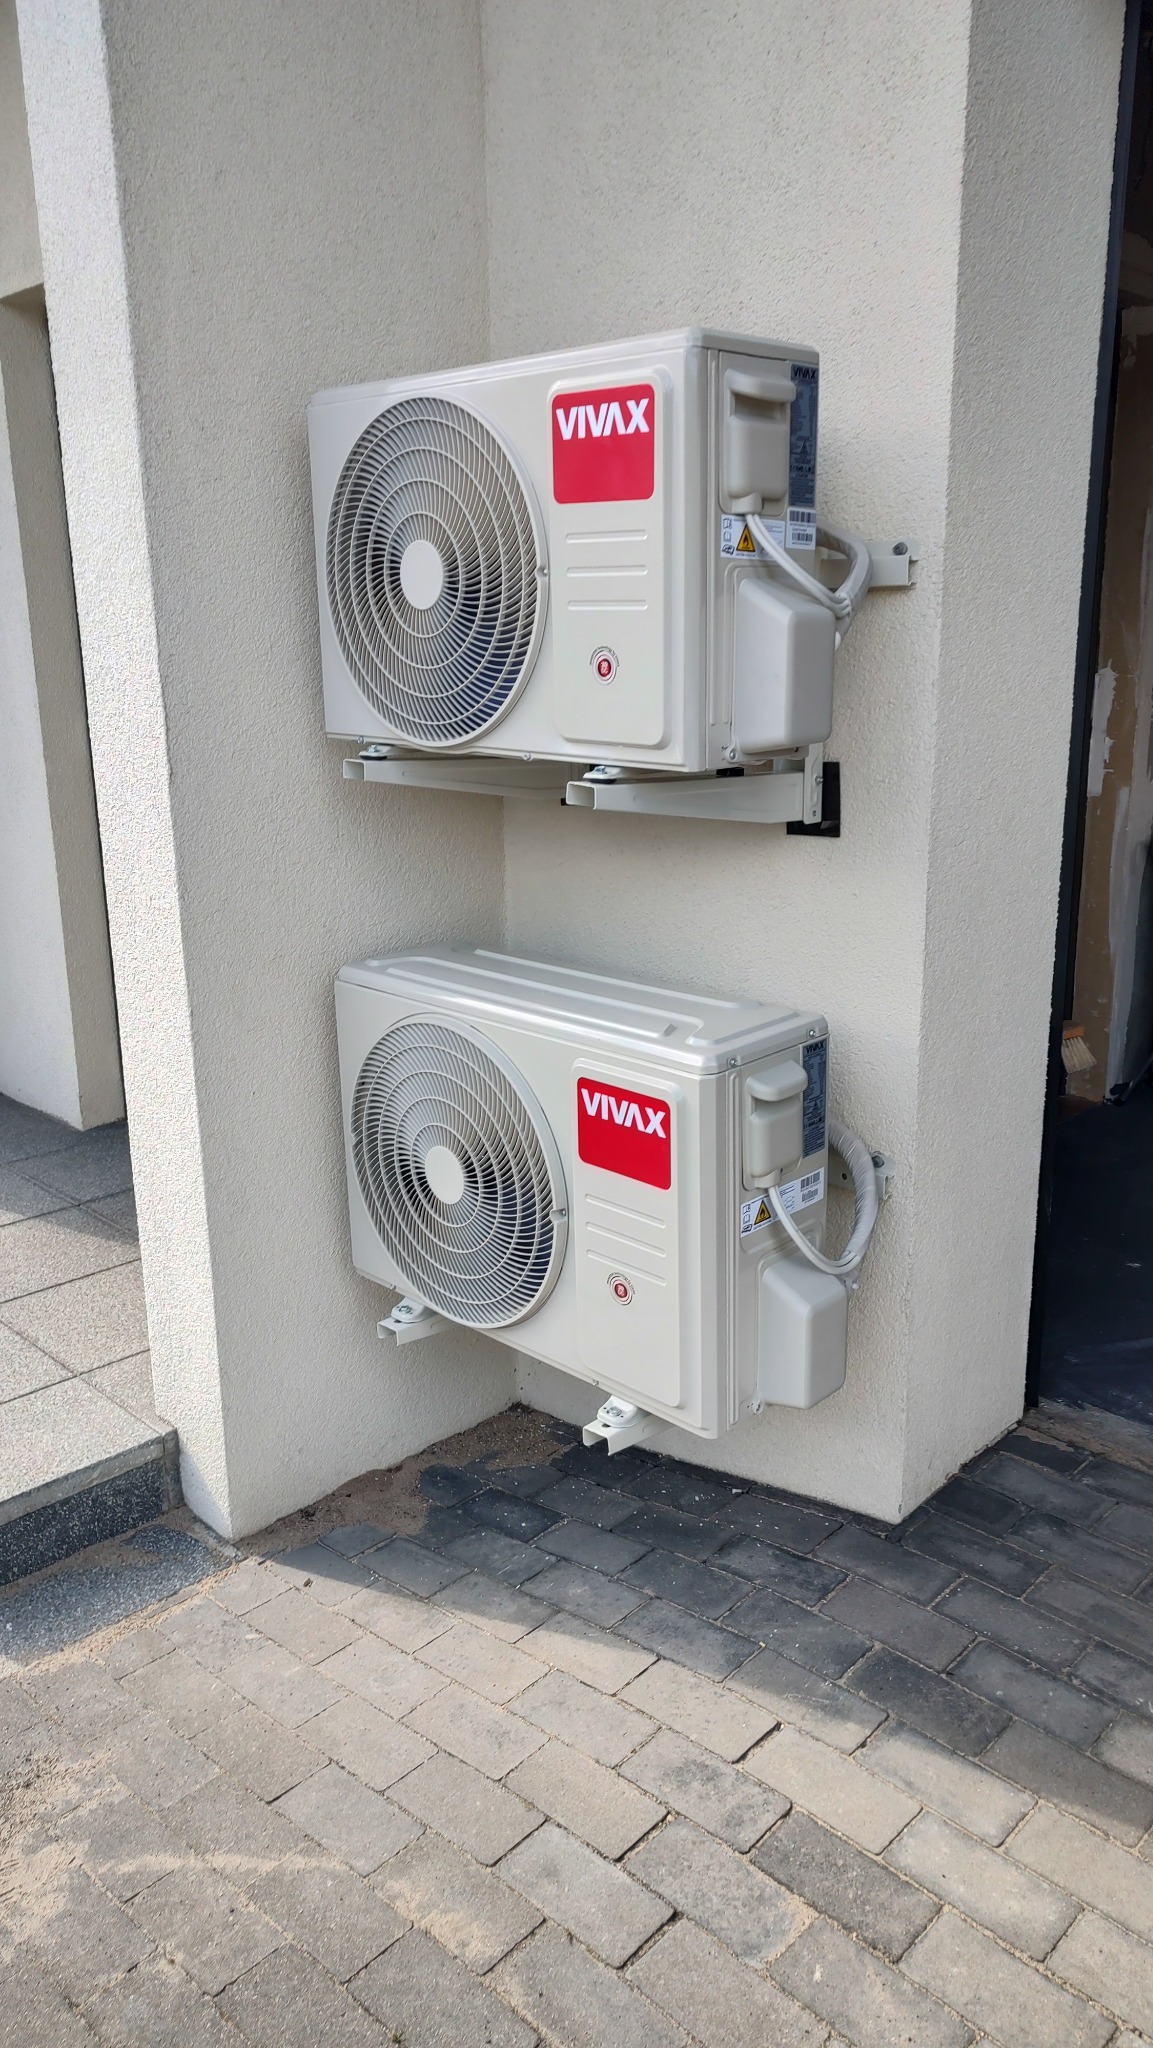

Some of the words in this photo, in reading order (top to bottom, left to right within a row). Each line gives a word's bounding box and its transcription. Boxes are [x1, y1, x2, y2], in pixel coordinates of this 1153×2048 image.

[793, 366, 817, 379] VIVAX
[556, 398, 650, 440] VIVAX
[805, 1041, 825, 1054] VIVAX
[581, 1088, 667, 1139] VIVAX
